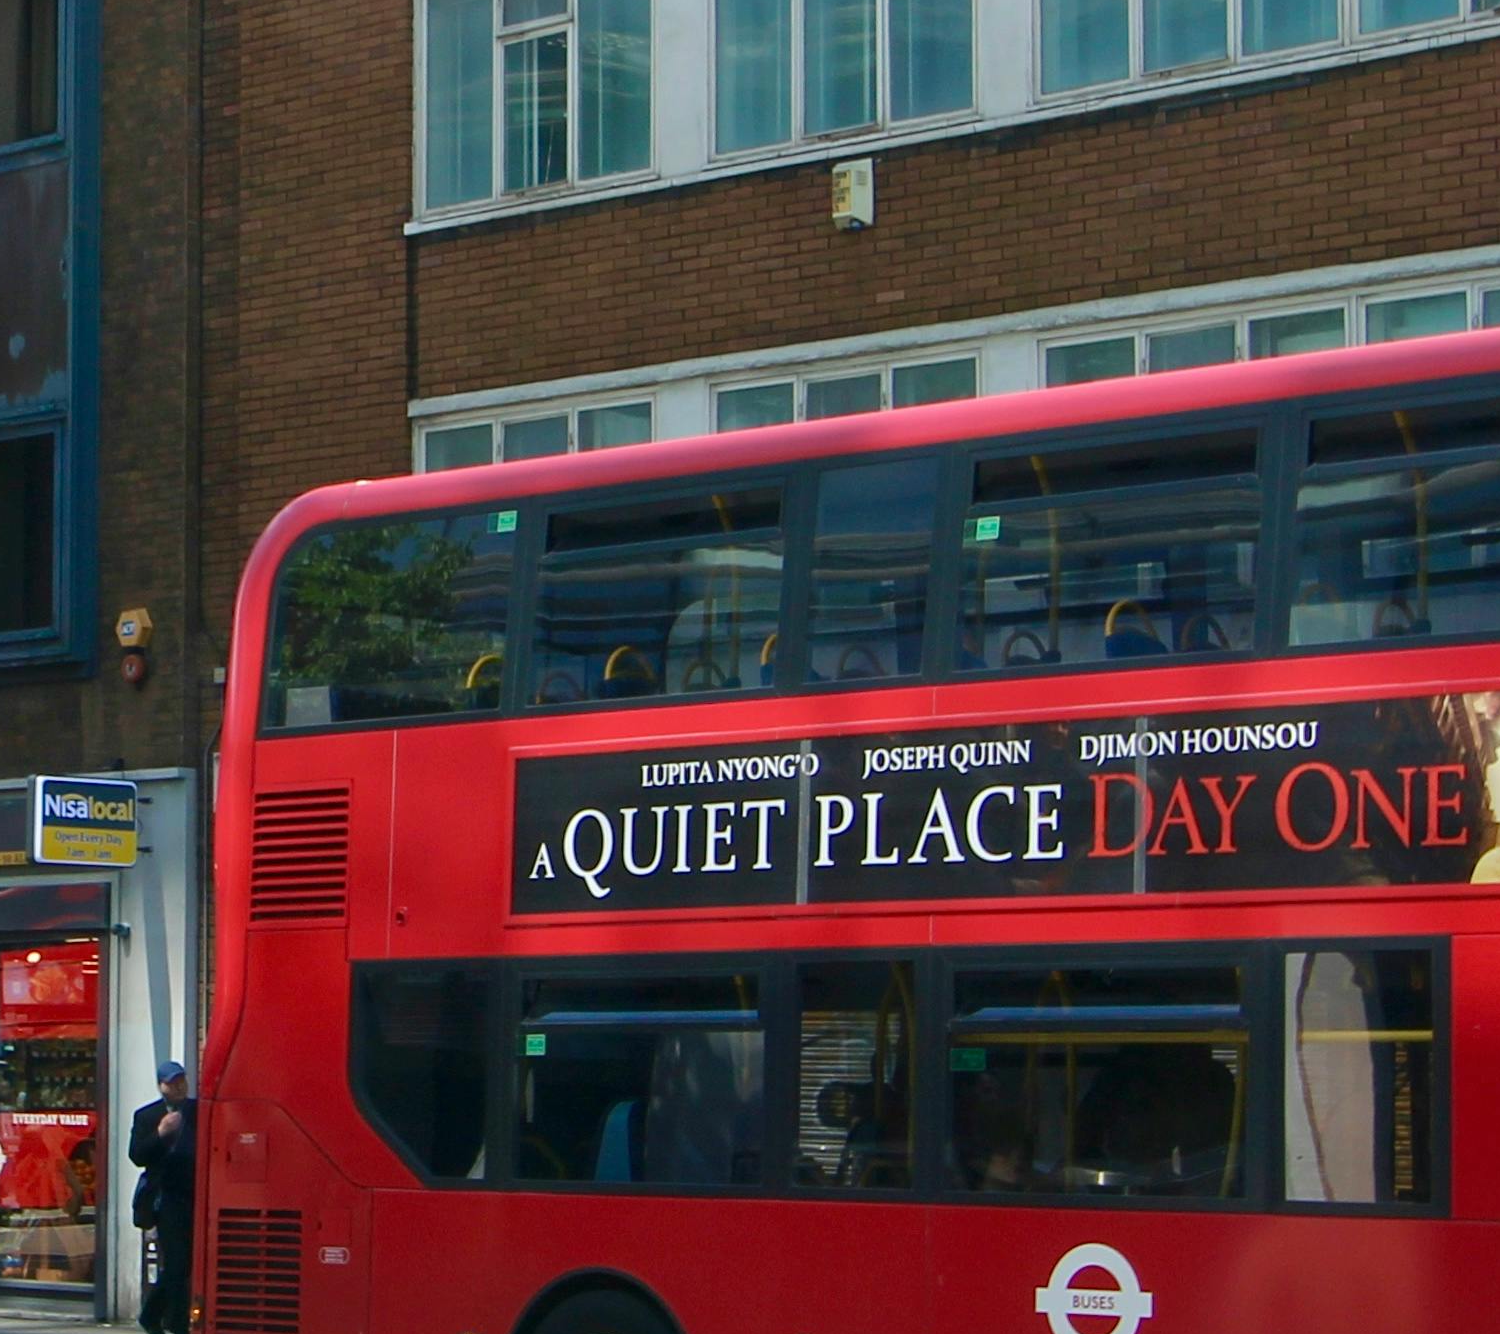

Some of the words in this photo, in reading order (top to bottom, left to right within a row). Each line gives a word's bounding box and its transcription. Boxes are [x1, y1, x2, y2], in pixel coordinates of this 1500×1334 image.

[640, 758, 715, 788] LUPITA
[718, 752, 820, 782] NYONG'O
[862, 745, 945, 780] JOSEPH
[948, 739, 1032, 775] QUINN
[1078, 730, 1178, 765] DJIMON
[1181, 721, 1319, 755] HOUNSOU
[55, 830, 79, 843] Open
[529, 841, 557, 881] A
[562, 798, 787, 898] QUIET
[812, 782, 1065, 868] PLACE
[1087, 772, 1258, 859] DAY
[1274, 761, 1470, 854] ONE
[1072, 1294, 1115, 1310] BUSES
